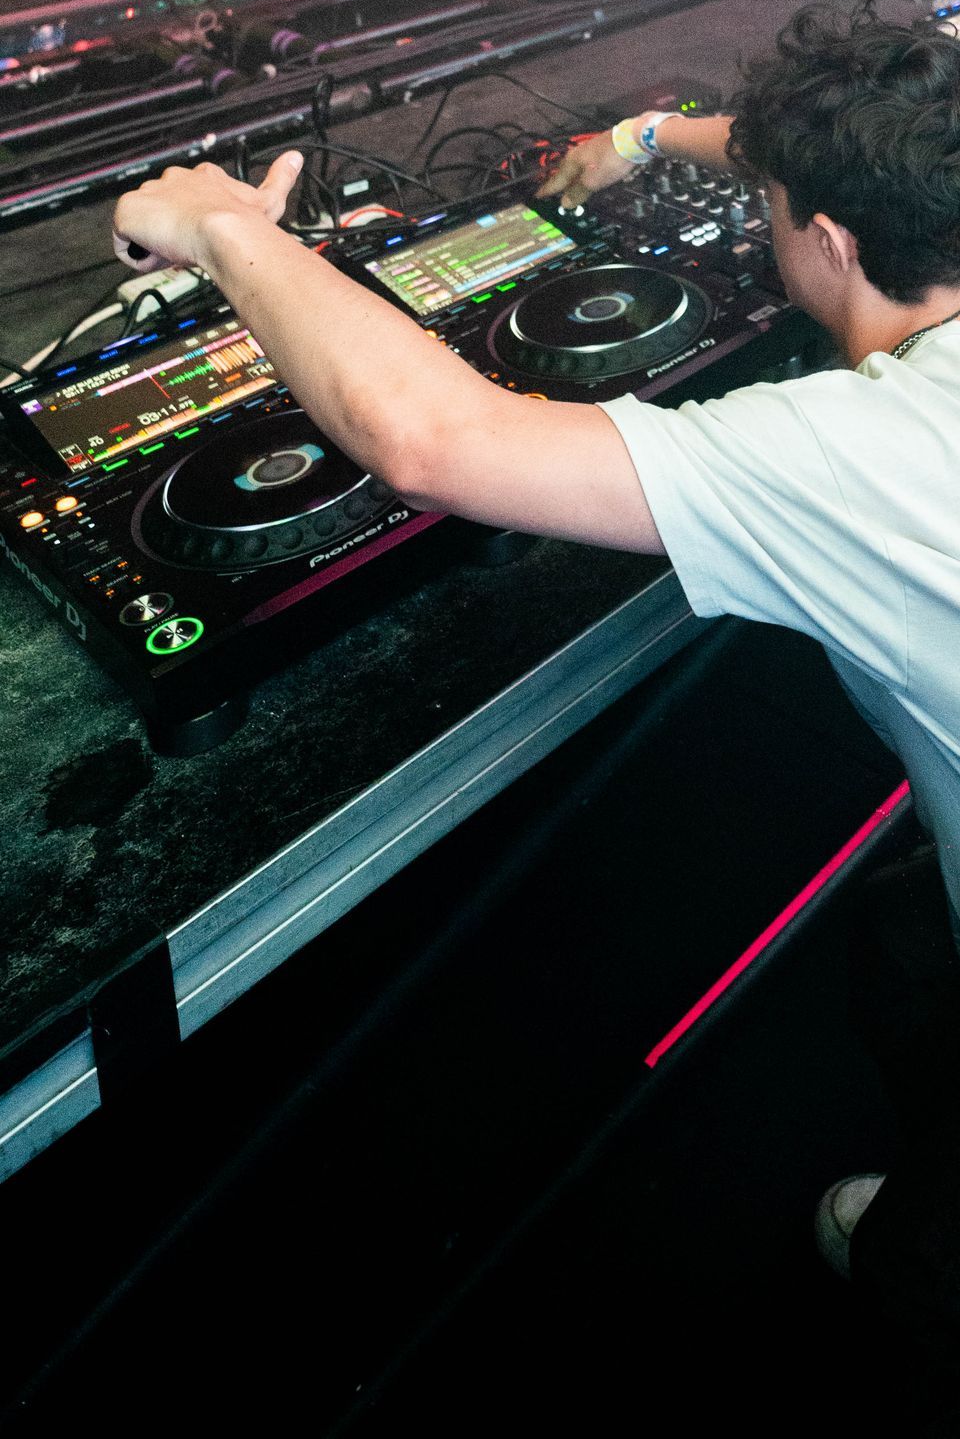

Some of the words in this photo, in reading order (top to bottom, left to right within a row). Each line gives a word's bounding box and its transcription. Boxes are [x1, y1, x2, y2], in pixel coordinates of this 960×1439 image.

[647, 347, 698, 378] Pioneer
[309, 523, 384, 569] Pioneer
[387, 509, 409, 525] DJ
